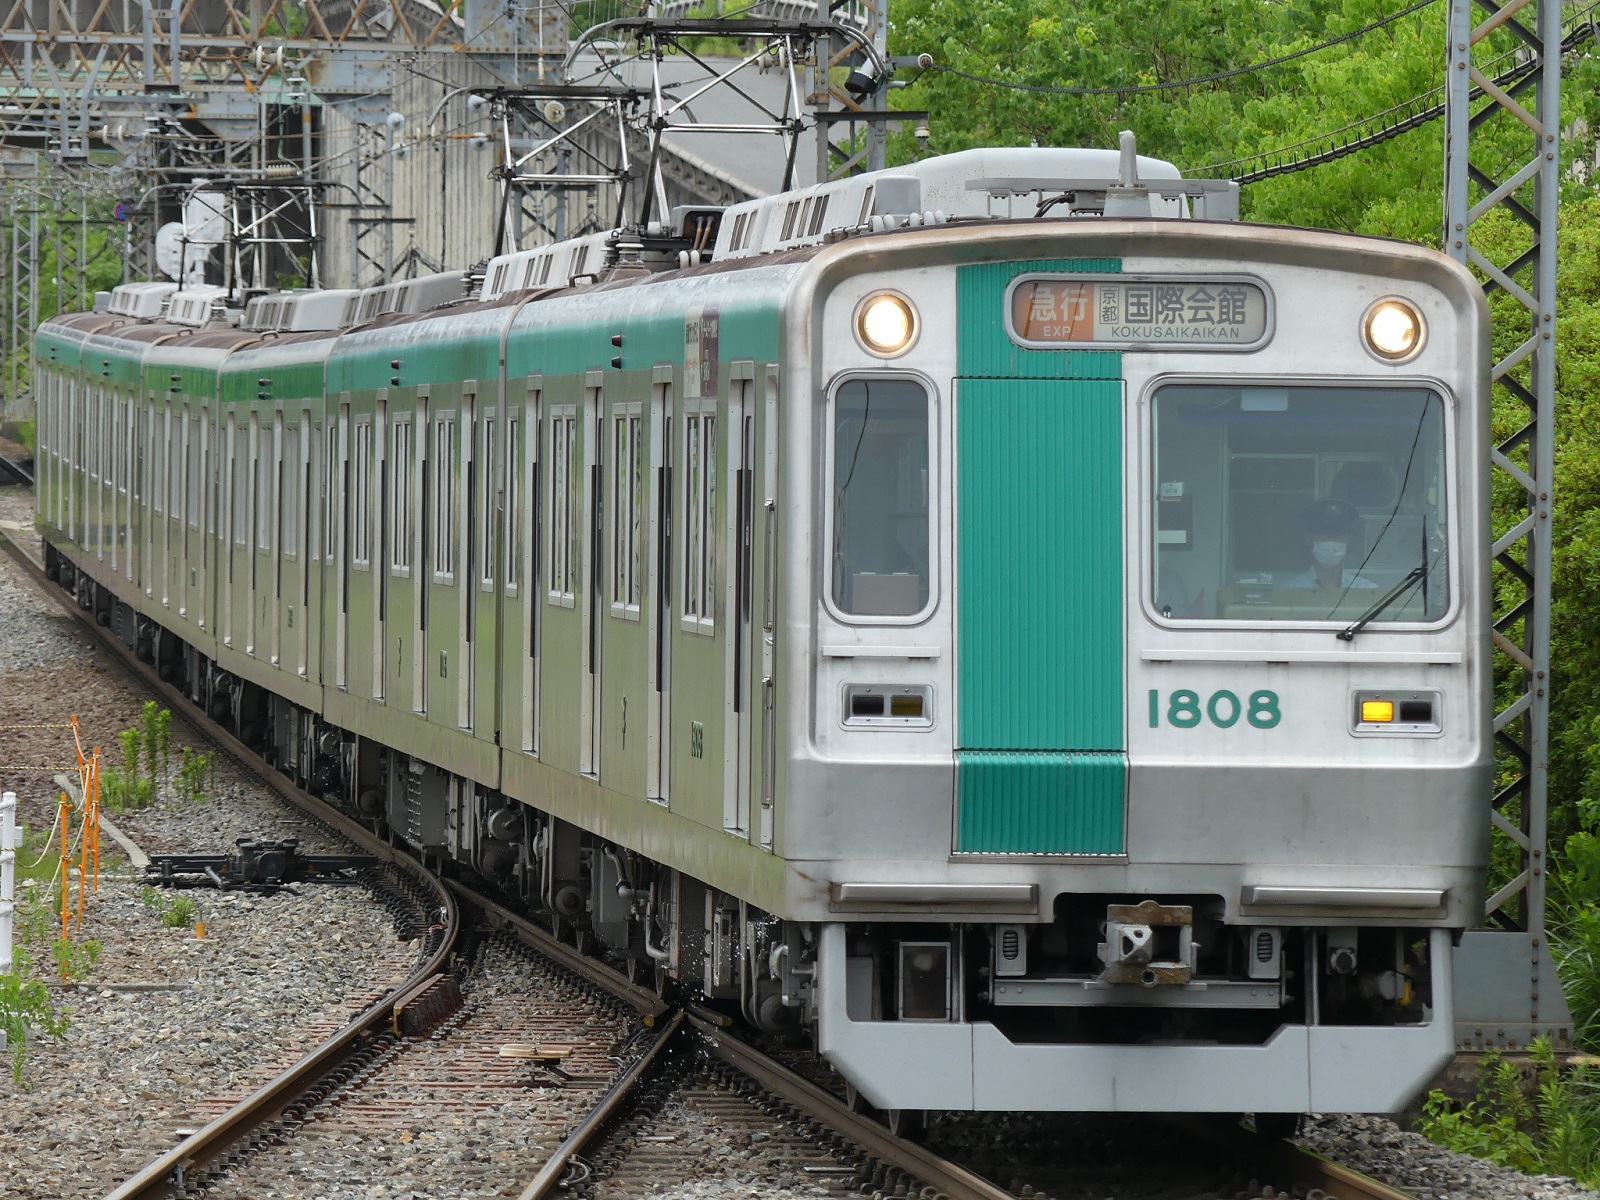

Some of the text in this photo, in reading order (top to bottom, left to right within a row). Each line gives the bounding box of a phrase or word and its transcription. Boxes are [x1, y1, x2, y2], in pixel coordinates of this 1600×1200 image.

[1029, 288, 1088, 322] 急行
[1102, 289, 1117, 322] 京都
[1125, 286, 1247, 325] 国際会館
[1111, 326, 1239, 338] KOKUSAIKAIKAN
[1149, 689, 1281, 729] 1808
